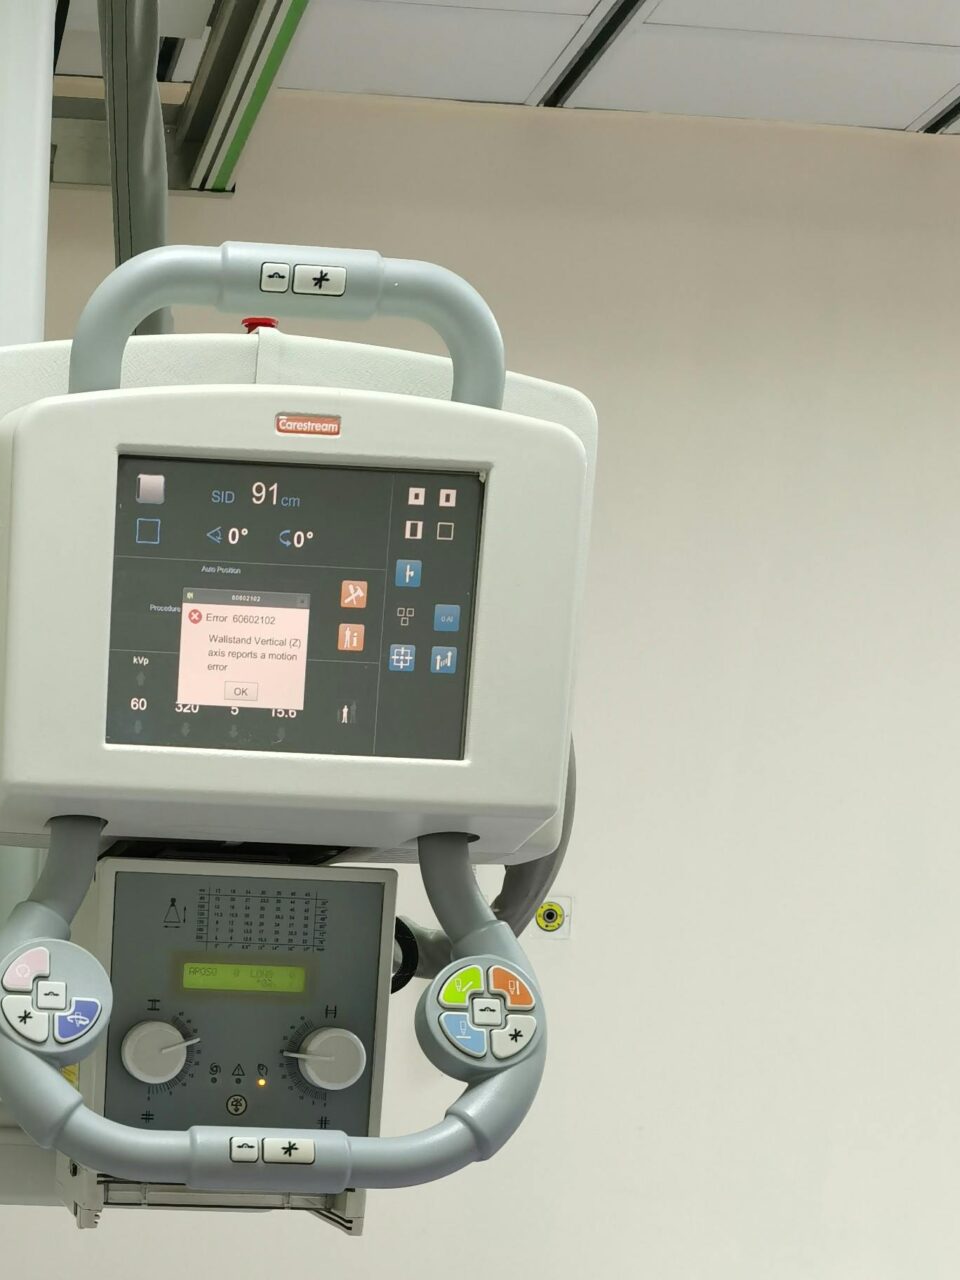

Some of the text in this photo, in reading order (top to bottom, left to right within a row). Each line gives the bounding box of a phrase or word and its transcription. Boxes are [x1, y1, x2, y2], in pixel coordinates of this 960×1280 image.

[279, 418, 338, 433] Carestream
[211, 481, 300, 507] SID 91 cm
[201, 565, 241, 575] Auto Position
[231, 594, 261, 602] 60602102
[150, 604, 180, 613] Procedure
[206, 613, 276, 625] Error 60602102
[208, 634, 302, 649] Wallstand Vertical (Z)
[208, 649, 225, 658] axis
[228, 650, 258, 662] reports
[268, 651, 298, 661] motion
[132, 656, 149, 666] kVp
[207, 663, 228, 671] error
[234, 687, 248, 697] OK
[130, 698, 147, 711] 60
[175, 703, 200, 713] 320
[230, 706, 239, 715] 5
